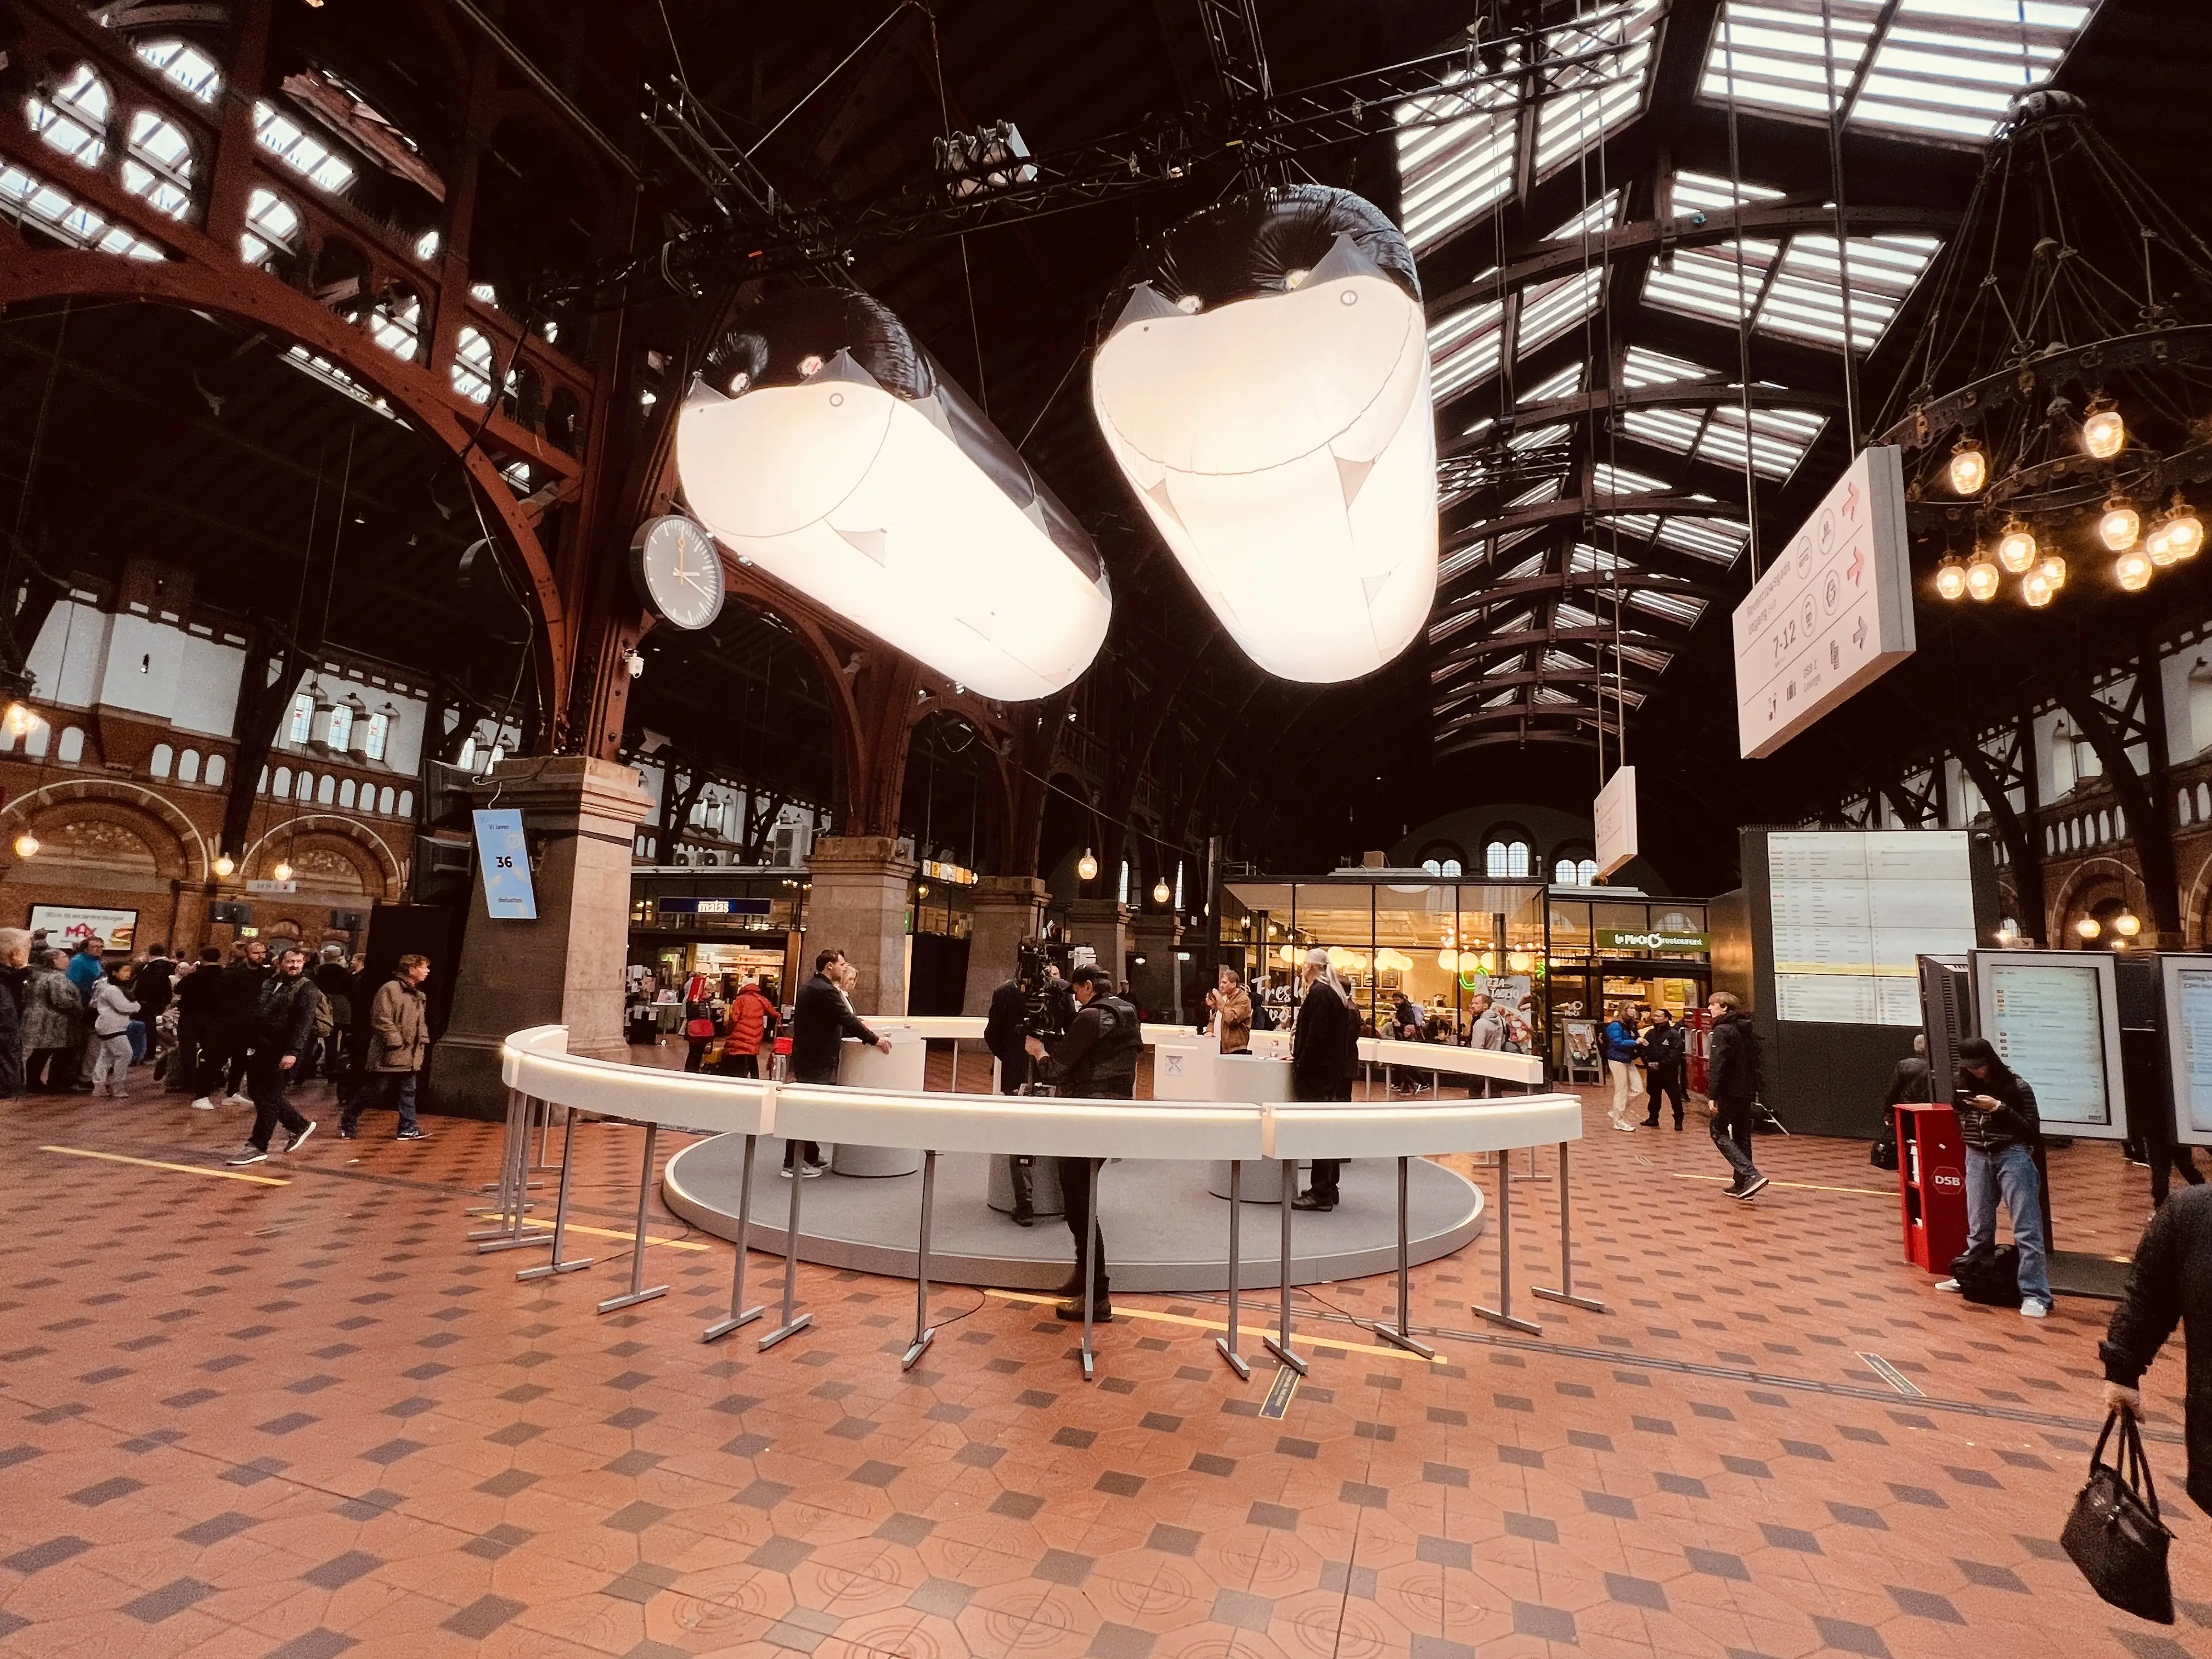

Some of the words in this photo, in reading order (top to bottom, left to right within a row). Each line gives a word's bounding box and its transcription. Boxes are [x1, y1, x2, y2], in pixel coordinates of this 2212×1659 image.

[496, 856, 512, 868] 36
[698, 899, 729, 913] matas
[1479, 978, 1505, 988] PIZZA
[1491, 988, 1520, 998] TAGLIO
[1934, 1175, 1961, 1186] DSB
